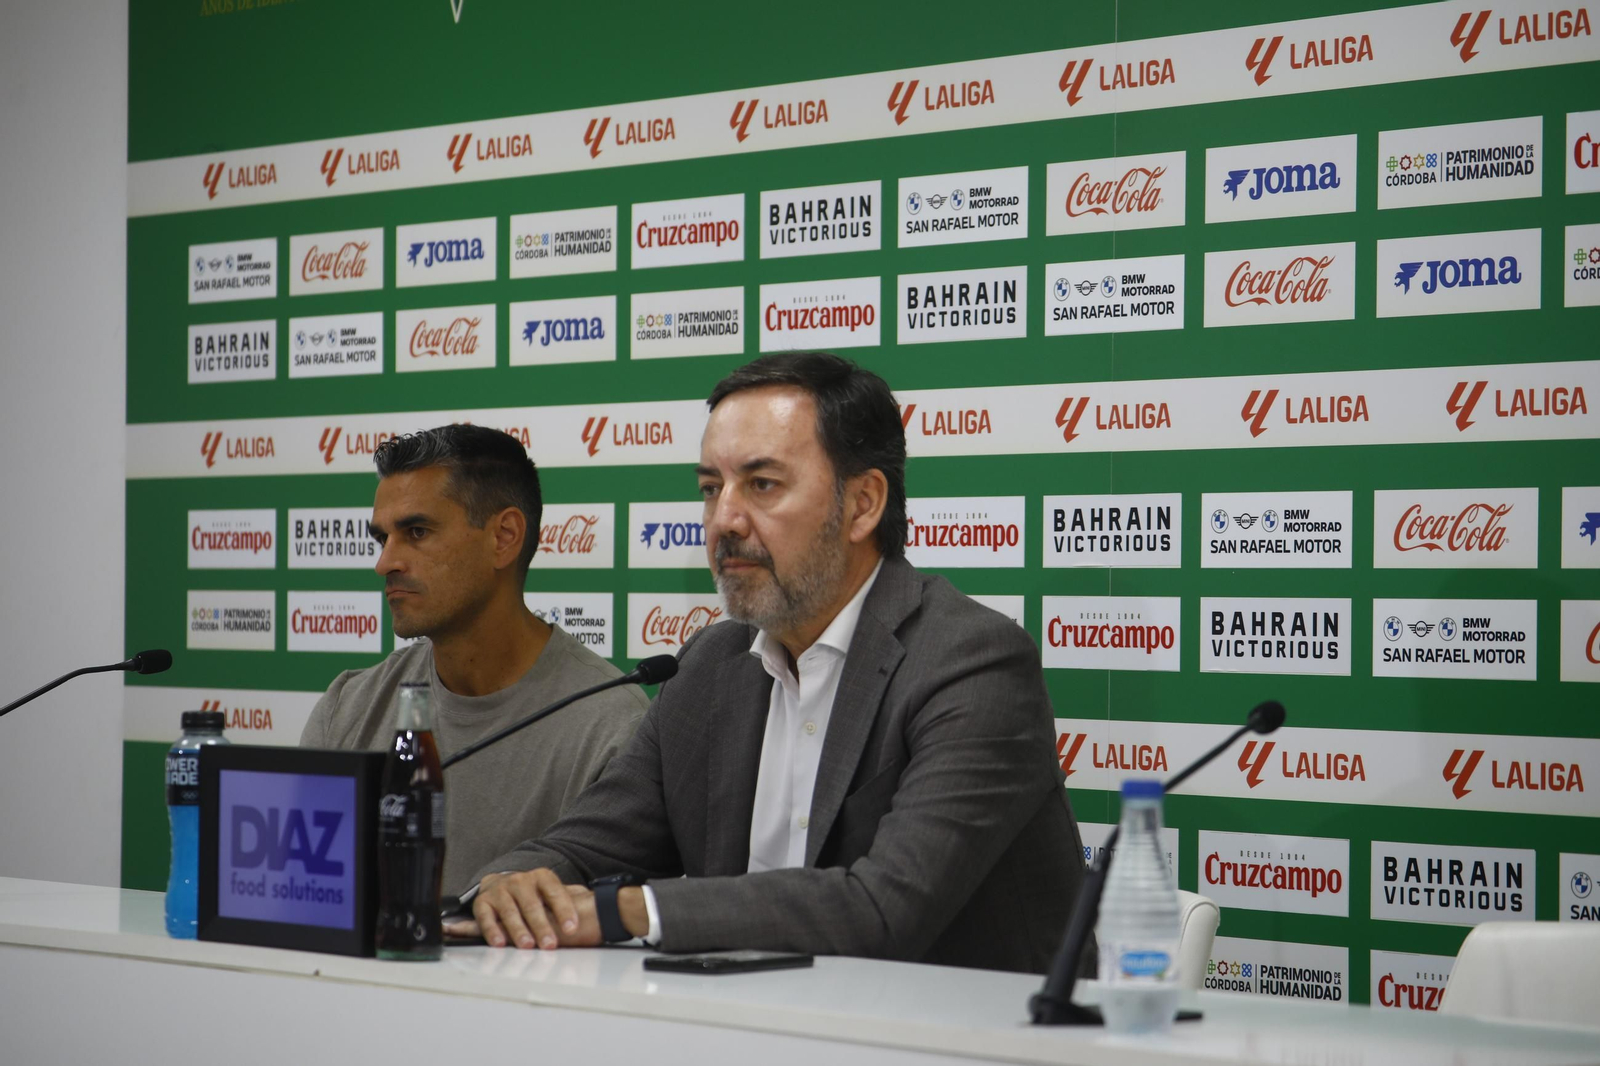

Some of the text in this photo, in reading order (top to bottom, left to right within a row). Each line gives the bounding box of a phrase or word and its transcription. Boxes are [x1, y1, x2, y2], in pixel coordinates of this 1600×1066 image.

[1499, 7, 1591, 45] LALIGA
[1290, 34, 1373, 69] LALIGA
[1099, 58, 1175, 91] LALIGA
[925, 79, 994, 111] LALIGA
[764, 99, 828, 129] LALIGA
[615, 117, 675, 145] LALIGA
[476, 133, 532, 161] LALIGA
[1446, 144, 1524, 165] PATRIMONIO
[348, 149, 400, 175] LALIGA
[1445, 159, 1534, 181] HUMANIDAD
[228, 163, 277, 188] LALIGA
[1385, 171, 1436, 187] CÓRDOBA
[969, 186, 991, 197] BMW
[969, 196, 1019, 209] MOTORRAD
[1065, 166, 1166, 217] Coca-Cola
[769, 194, 871, 226] BAHRAIN
[636, 219, 739, 248] Cruzcampo
[769, 220, 871, 245] VICTORIOUS
[906, 212, 1018, 234] SAN RAFAEL MOTOR
[554, 228, 605, 243] PATRIMONIO
[515, 248, 548, 260] CÓRDOBA
[554, 240, 611, 256] HUMANIDAD
[237, 261, 271, 271] MOTORRAD
[301, 241, 368, 282] Coca-Cola
[194, 274, 270, 291] SAN RAFAEL MOTOR
[1121, 273, 1145, 284] BMW
[1224, 256, 1334, 307] Coca-Cola
[907, 279, 1016, 309] BAHRAIN
[1121, 284, 1175, 297] MOTORRAD
[678, 309, 731, 323] PATRIMONIO
[765, 302, 875, 332] Cruzcampo
[907, 306, 1016, 329] VICTORIOUS
[1053, 300, 1174, 321] SAN RAFAEL MOTOR
[340, 328, 356, 336] BMW
[409, 317, 480, 358] Coca-Cola
[636, 329, 672, 340] CÓRDOBA
[677, 321, 738, 337] HUMANIDAD
[194, 332, 269, 355] BAHRAIN
[340, 336, 376, 346] MOTORRAD
[195, 353, 269, 371] VICTORIOUS
[295, 350, 376, 366] SAN RAFAEL MOTOR
[1285, 395, 1369, 424] LALIGA
[1495, 386, 1587, 417] LALIGA
[922, 409, 991, 436] LALIGA
[1096, 402, 1171, 430] LALIGA
[613, 421, 672, 446] LALIGA
[226, 436, 275, 458] LALIGA
[1053, 506, 1170, 532] BAHRAIN
[1283, 509, 1310, 519] BMW
[537, 515, 600, 554] ca-Cola
[659, 522, 706, 551] Jom
[1283, 521, 1341, 532] MOTORRAD
[1393, 503, 1512, 551] Coca-Cola
[191, 525, 272, 554] Cruzcampo
[295, 539, 376, 556] VICTORIOUS
[1053, 534, 1170, 552] VICTORIOUS
[1210, 538, 1341, 553] SAN RAFAEL MOTOR
[223, 609, 267, 622] PATRIMONIO
[564, 617, 605, 627] MOTORRAD
[565, 607, 583, 615] BMW
[191, 621, 219, 631] CÓRDOBA
[223, 620, 271, 632] HUMANIDAD
[291, 608, 377, 638] Cruzcampo
[1047, 613, 1174, 654] Cruzcampo
[1211, 611, 1338, 637] BAHRAIN
[1462, 617, 1490, 628] BMW
[1462, 630, 1525, 641] MOTORRAD
[1211, 639, 1338, 659] VICTORIOUS
[1383, 647, 1525, 664] SAN RAFAEL MOTOR
[223, 708, 272, 730] LALIGA
[1092, 742, 1167, 771] LALIGA
[1282, 751, 1365, 781] LALIGA
[1491, 760, 1583, 792] LALIGA
[230, 805, 343, 877] DIAZ
[1204, 851, 1342, 898] Cruzcampo
[1383, 856, 1522, 889] BAHRAIN
[230, 872, 344, 905] food solutions
[1383, 885, 1521, 912] VICTORIOUS
[1204, 976, 1252, 993] CÓRDOBA
[1260, 964, 1332, 984] PATRIMONIO
[1331, 971, 1341, 980] DE
[1331, 977, 1341, 985] LA
[1259, 979, 1341, 1001] HUMANIDAD
